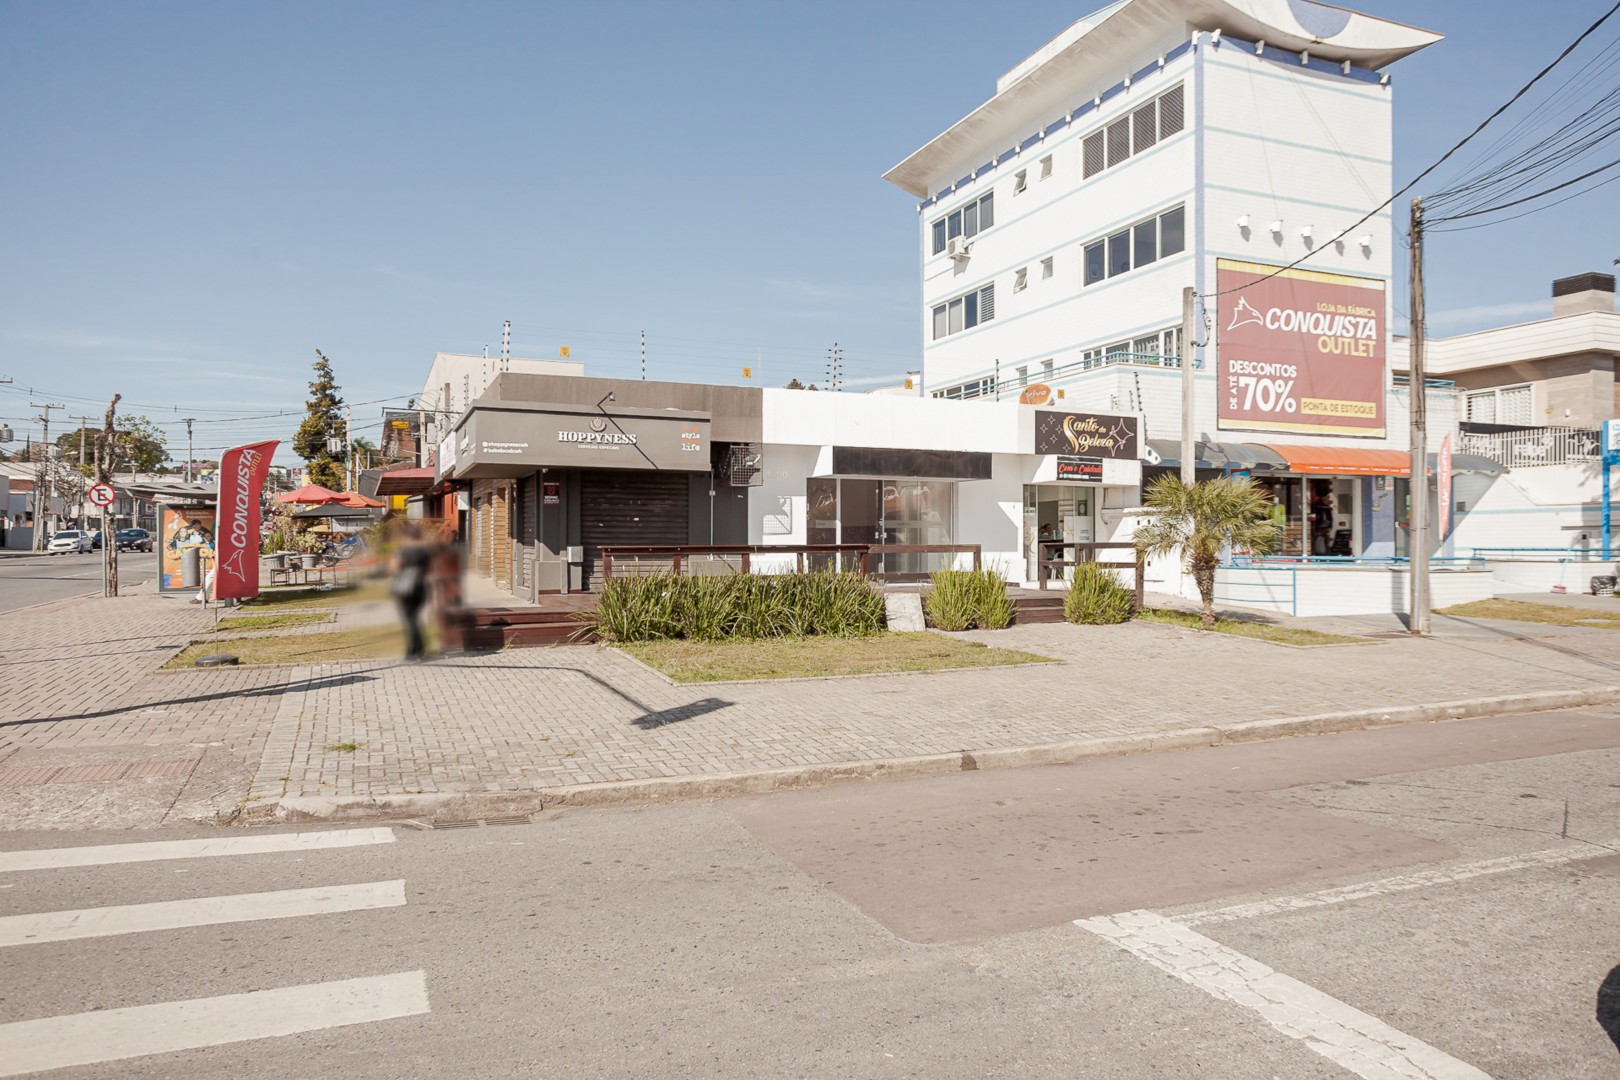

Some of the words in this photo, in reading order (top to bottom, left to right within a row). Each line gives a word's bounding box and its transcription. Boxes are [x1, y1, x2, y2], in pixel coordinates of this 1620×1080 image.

[1316, 302, 1336, 312] LOJA
[1336, 304, 1347, 314] DA
[1265, 307, 1377, 340] CONQUISTA
[1317, 336, 1377, 357] OUTLET
[1229, 359, 1297, 378] DESCONTOS
[1026, 389, 1047, 399] vivo
[1227, 376, 1238, 395] ATÉ
[1238, 376, 1297, 413] 70%
[1229, 397, 1238, 410] DE
[1303, 401, 1328, 412] PONTA
[1330, 402, 1339, 413] DE
[1341, 403, 1375, 415] ESTOQUE
[557, 431, 637, 445] HOPPYNESS
[681, 443, 701, 451] life
[1078, 434, 1115, 453] Beleza
[250, 452, 263, 476] OUTLET
[231, 448, 256, 548] CONQUISTA
